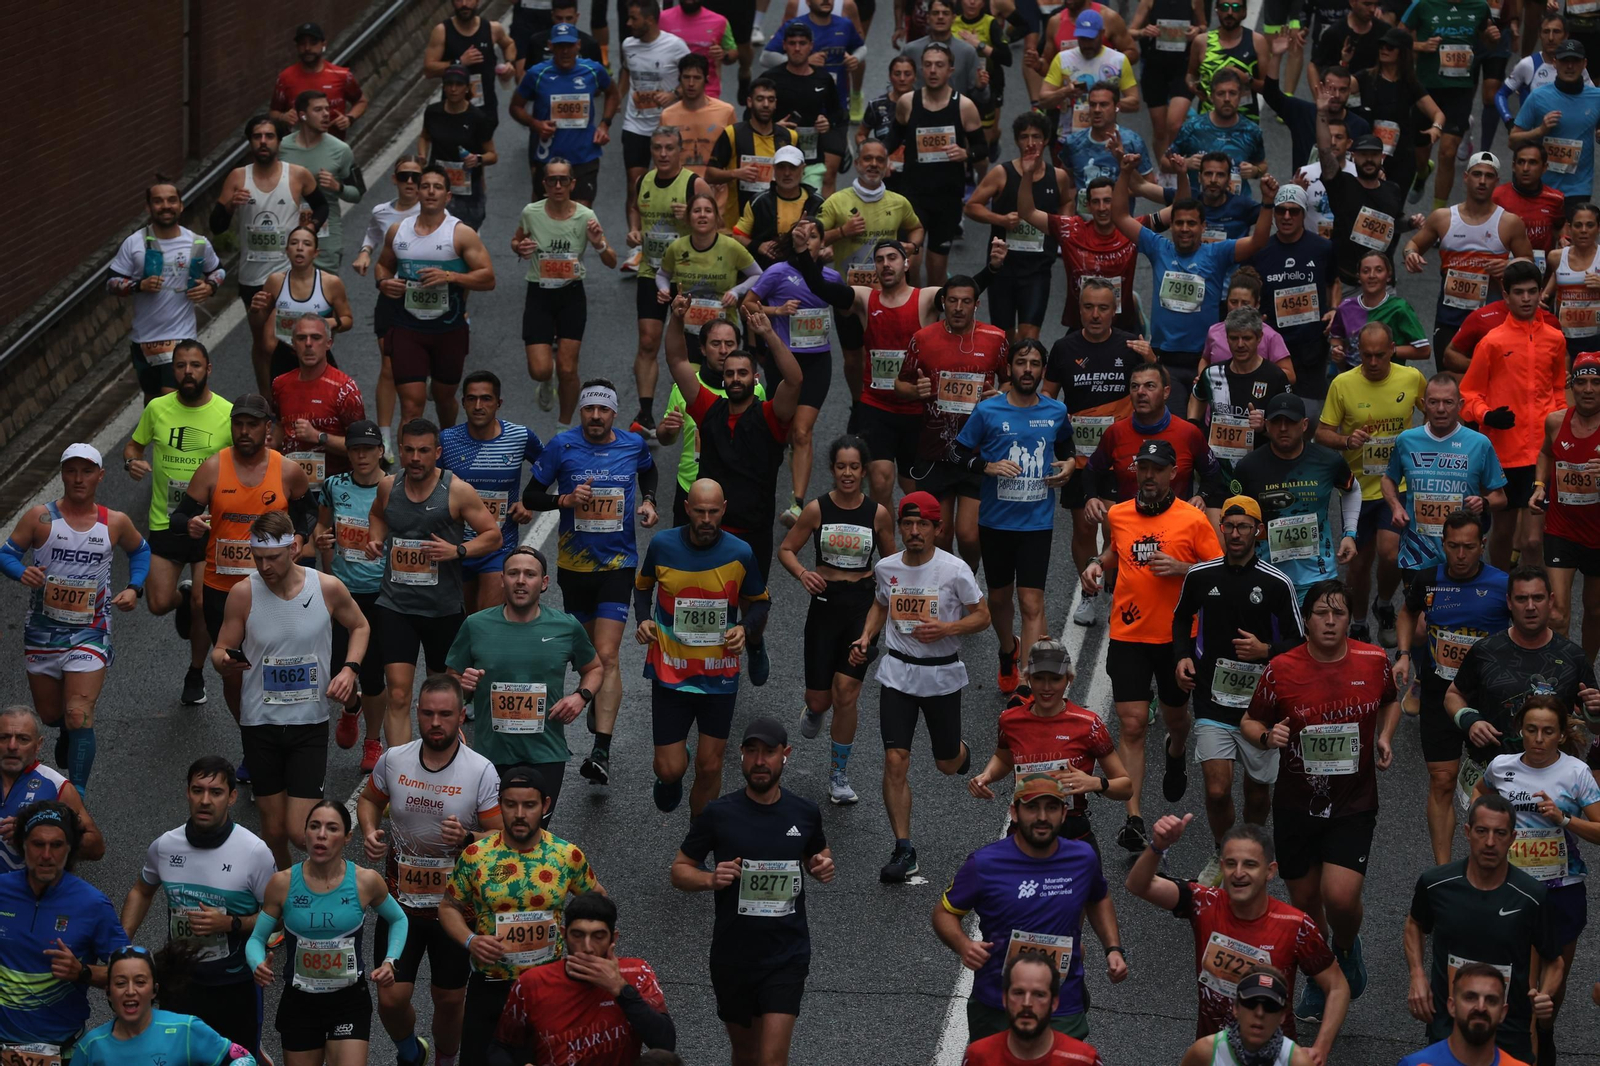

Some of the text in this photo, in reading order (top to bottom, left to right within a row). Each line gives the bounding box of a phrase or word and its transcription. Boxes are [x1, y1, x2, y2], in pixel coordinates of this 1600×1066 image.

[1445, 52, 1468, 63] 5189
[557, 103, 581, 114] 5069
[922, 135, 947, 147] 6265
[1548, 145, 1573, 159] 5254
[1361, 217, 1387, 234] 5628
[251, 234, 276, 246] 6558
[545, 262, 571, 273] 5845
[1168, 281, 1195, 296] 7919
[1451, 280, 1477, 294] 3807
[412, 291, 438, 304] 6829
[1281, 295, 1309, 309] 4545
[689, 309, 716, 320] 5325
[1565, 310, 1592, 322] 5107
[796, 317, 823, 330] 7183
[876, 360, 900, 373] 7121
[1073, 373, 1126, 382] VALENCIA
[943, 382, 973, 396] 4679
[1091, 383, 1125, 393] FASTER
[1074, 426, 1103, 441] 6614
[1215, 427, 1242, 441] 5187
[162, 454, 196, 465] HIERROS
[1438, 458, 1468, 470] ULSA
[1281, 480, 1319, 489] BALILLAS
[1411, 480, 1468, 494] ATLETISMO
[1562, 473, 1591, 488] 4893
[581, 499, 613, 513] 6177
[1420, 503, 1451, 518] 5213
[1276, 526, 1308, 542] 7436
[828, 534, 860, 550] 9892
[1133, 542, 1158, 552] LIMIT
[50, 548, 103, 564] MEGA
[220, 545, 252, 560] 4652
[396, 549, 425, 566] 6180
[50, 590, 85, 605] 3707
[895, 598, 926, 614] 6027
[682, 610, 717, 626] 7818
[270, 667, 306, 684] 1662
[1221, 671, 1256, 688] 7942
[498, 695, 534, 711] 3874
[1310, 736, 1346, 752] 7877
[72, 737, 88, 781] kalenji
[397, 774, 462, 795] Runningzgz
[405, 794, 445, 809] belsue
[1512, 841, 1558, 859] 11425
[404, 872, 441, 886] 4418
[750, 875, 789, 892] 8277
[1044, 877, 1072, 885] Marathon
[184, 889, 227, 903] CRISTALERIA
[1048, 888, 1072, 897] Montréal
[309, 913, 335, 930] LR
[506, 925, 546, 943] 4919
[302, 952, 342, 971] 6834
